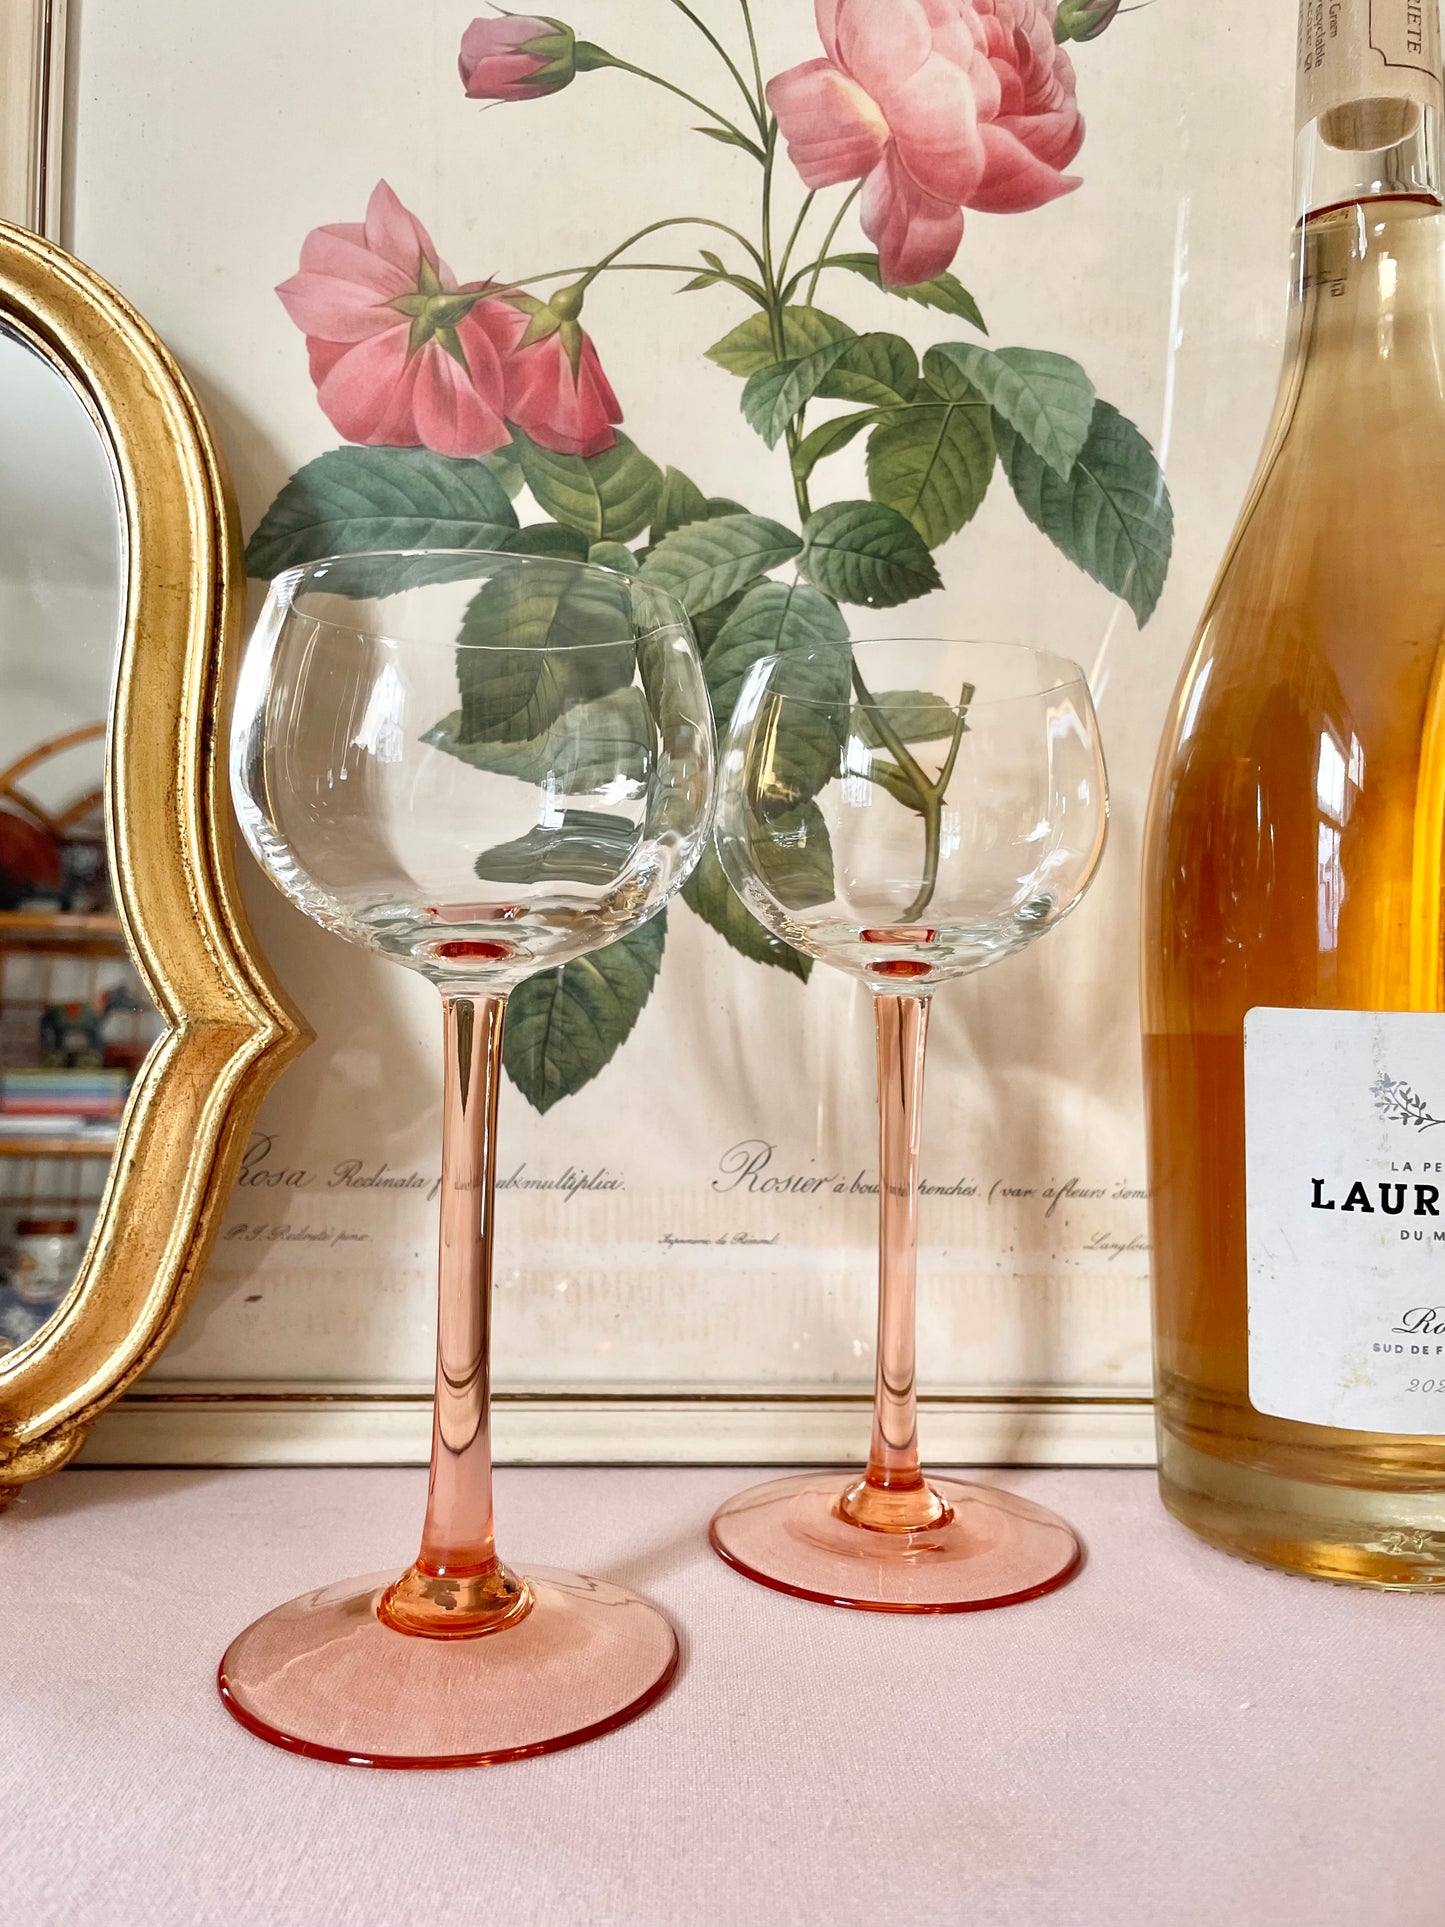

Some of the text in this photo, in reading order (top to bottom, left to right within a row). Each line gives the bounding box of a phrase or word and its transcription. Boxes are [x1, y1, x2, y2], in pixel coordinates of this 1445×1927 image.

[1314, 0, 1326, 69] ecyclable
[238, 1132, 318, 1188] Rosa
[711, 1139, 838, 1194] Rosier
[1391, 1161, 1443, 1173] LA PE
[1310, 1177, 1440, 1216] LAUR
[1400, 1229, 1423, 1241] DU
[1391, 1306, 1445, 1335] Ro
[1373, 1342, 1404, 1354] SUD
[1410, 1345, 1430, 1356] DE
[1404, 1378, 1445, 1394] 202
